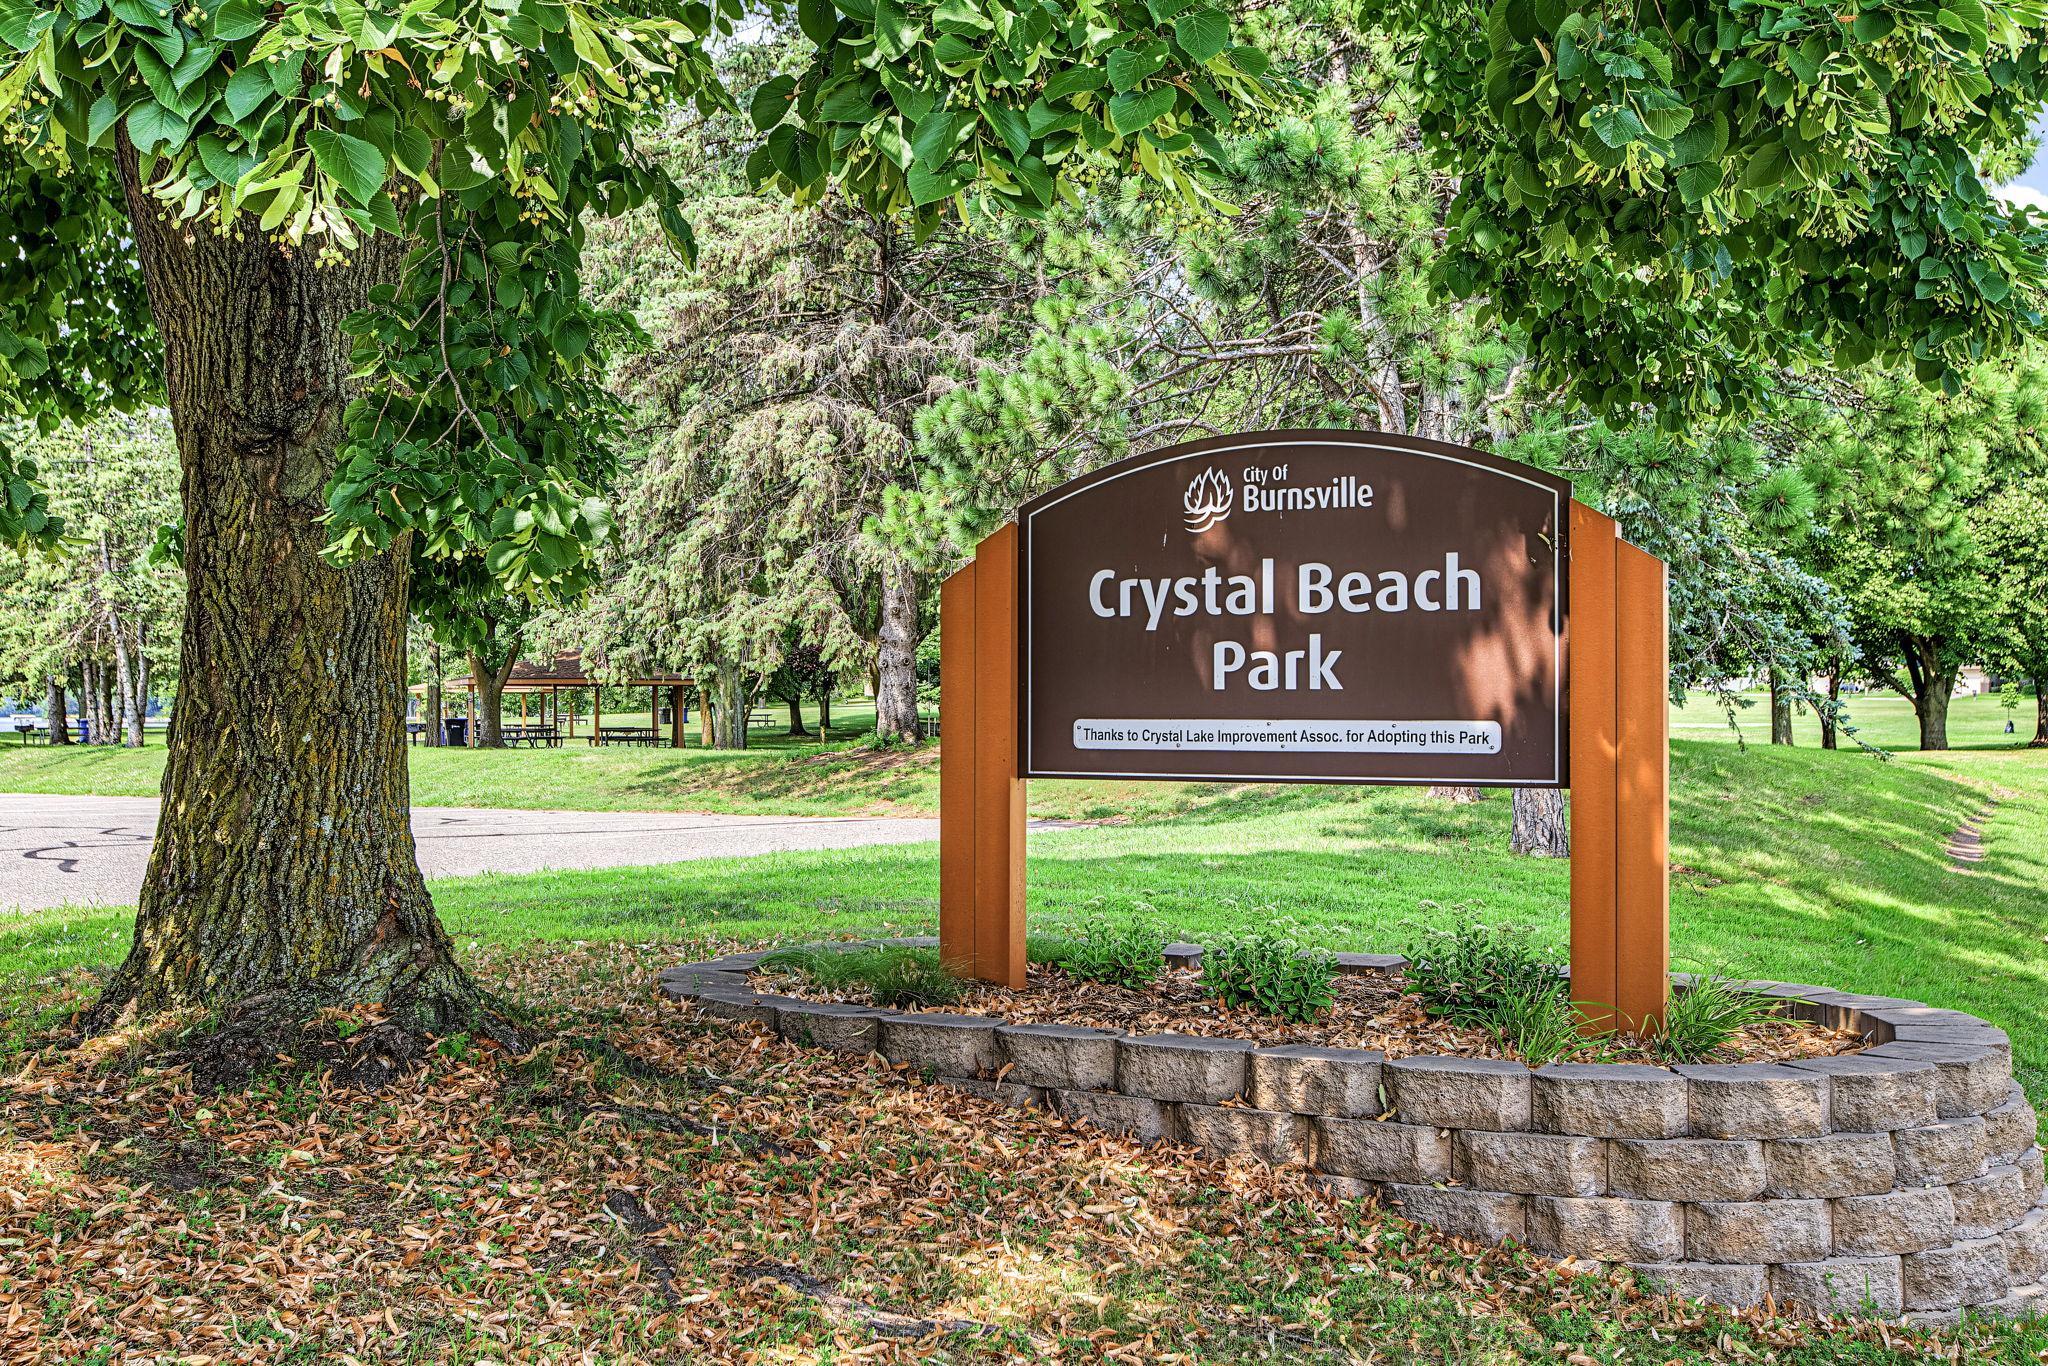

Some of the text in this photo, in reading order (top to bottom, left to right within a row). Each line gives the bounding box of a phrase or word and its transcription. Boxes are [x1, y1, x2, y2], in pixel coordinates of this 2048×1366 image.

[1243, 463, 1288, 486] City Of
[1243, 475, 1374, 512] Burnsville
[1089, 551, 1481, 631] Crystal Beach
[1213, 633, 1344, 691] Park
[1083, 727, 1490, 747] Thanks to Crystal Lake Improvement Assoc. for Adopting this Park
